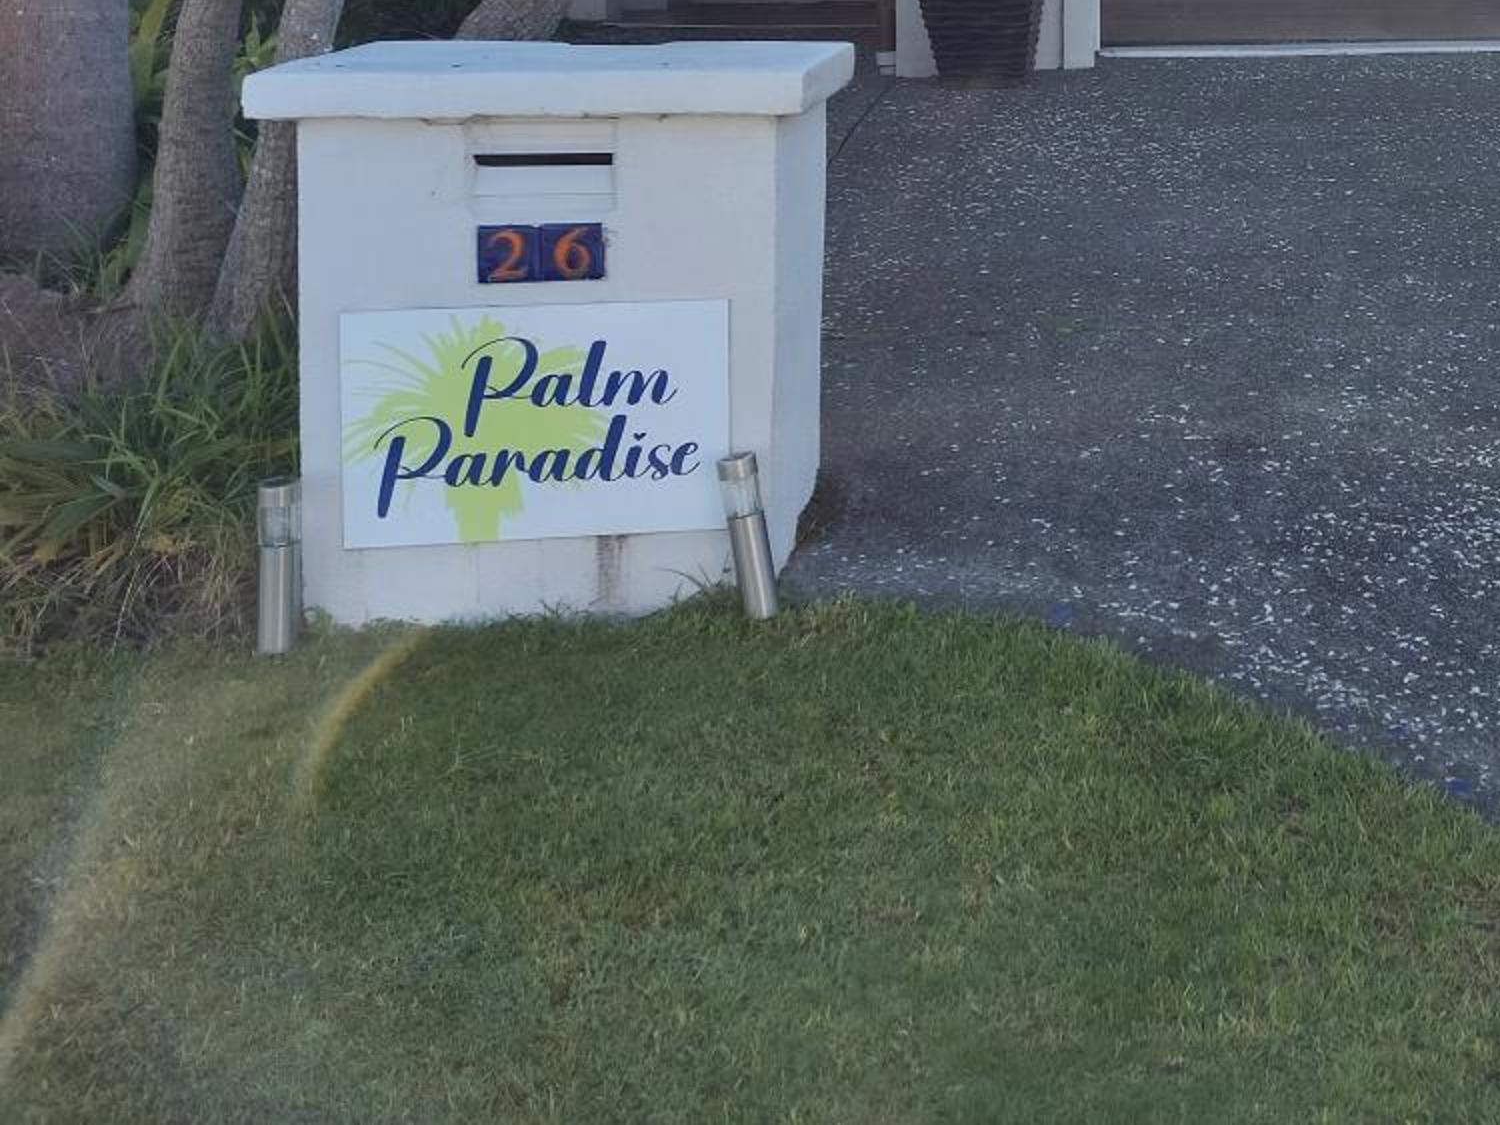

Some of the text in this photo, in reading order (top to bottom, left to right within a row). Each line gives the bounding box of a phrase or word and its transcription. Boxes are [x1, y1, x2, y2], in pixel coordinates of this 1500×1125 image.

[488, 228, 592, 280] 26
[461, 337, 678, 437] Palm
[374, 415, 700, 518] Paradise
